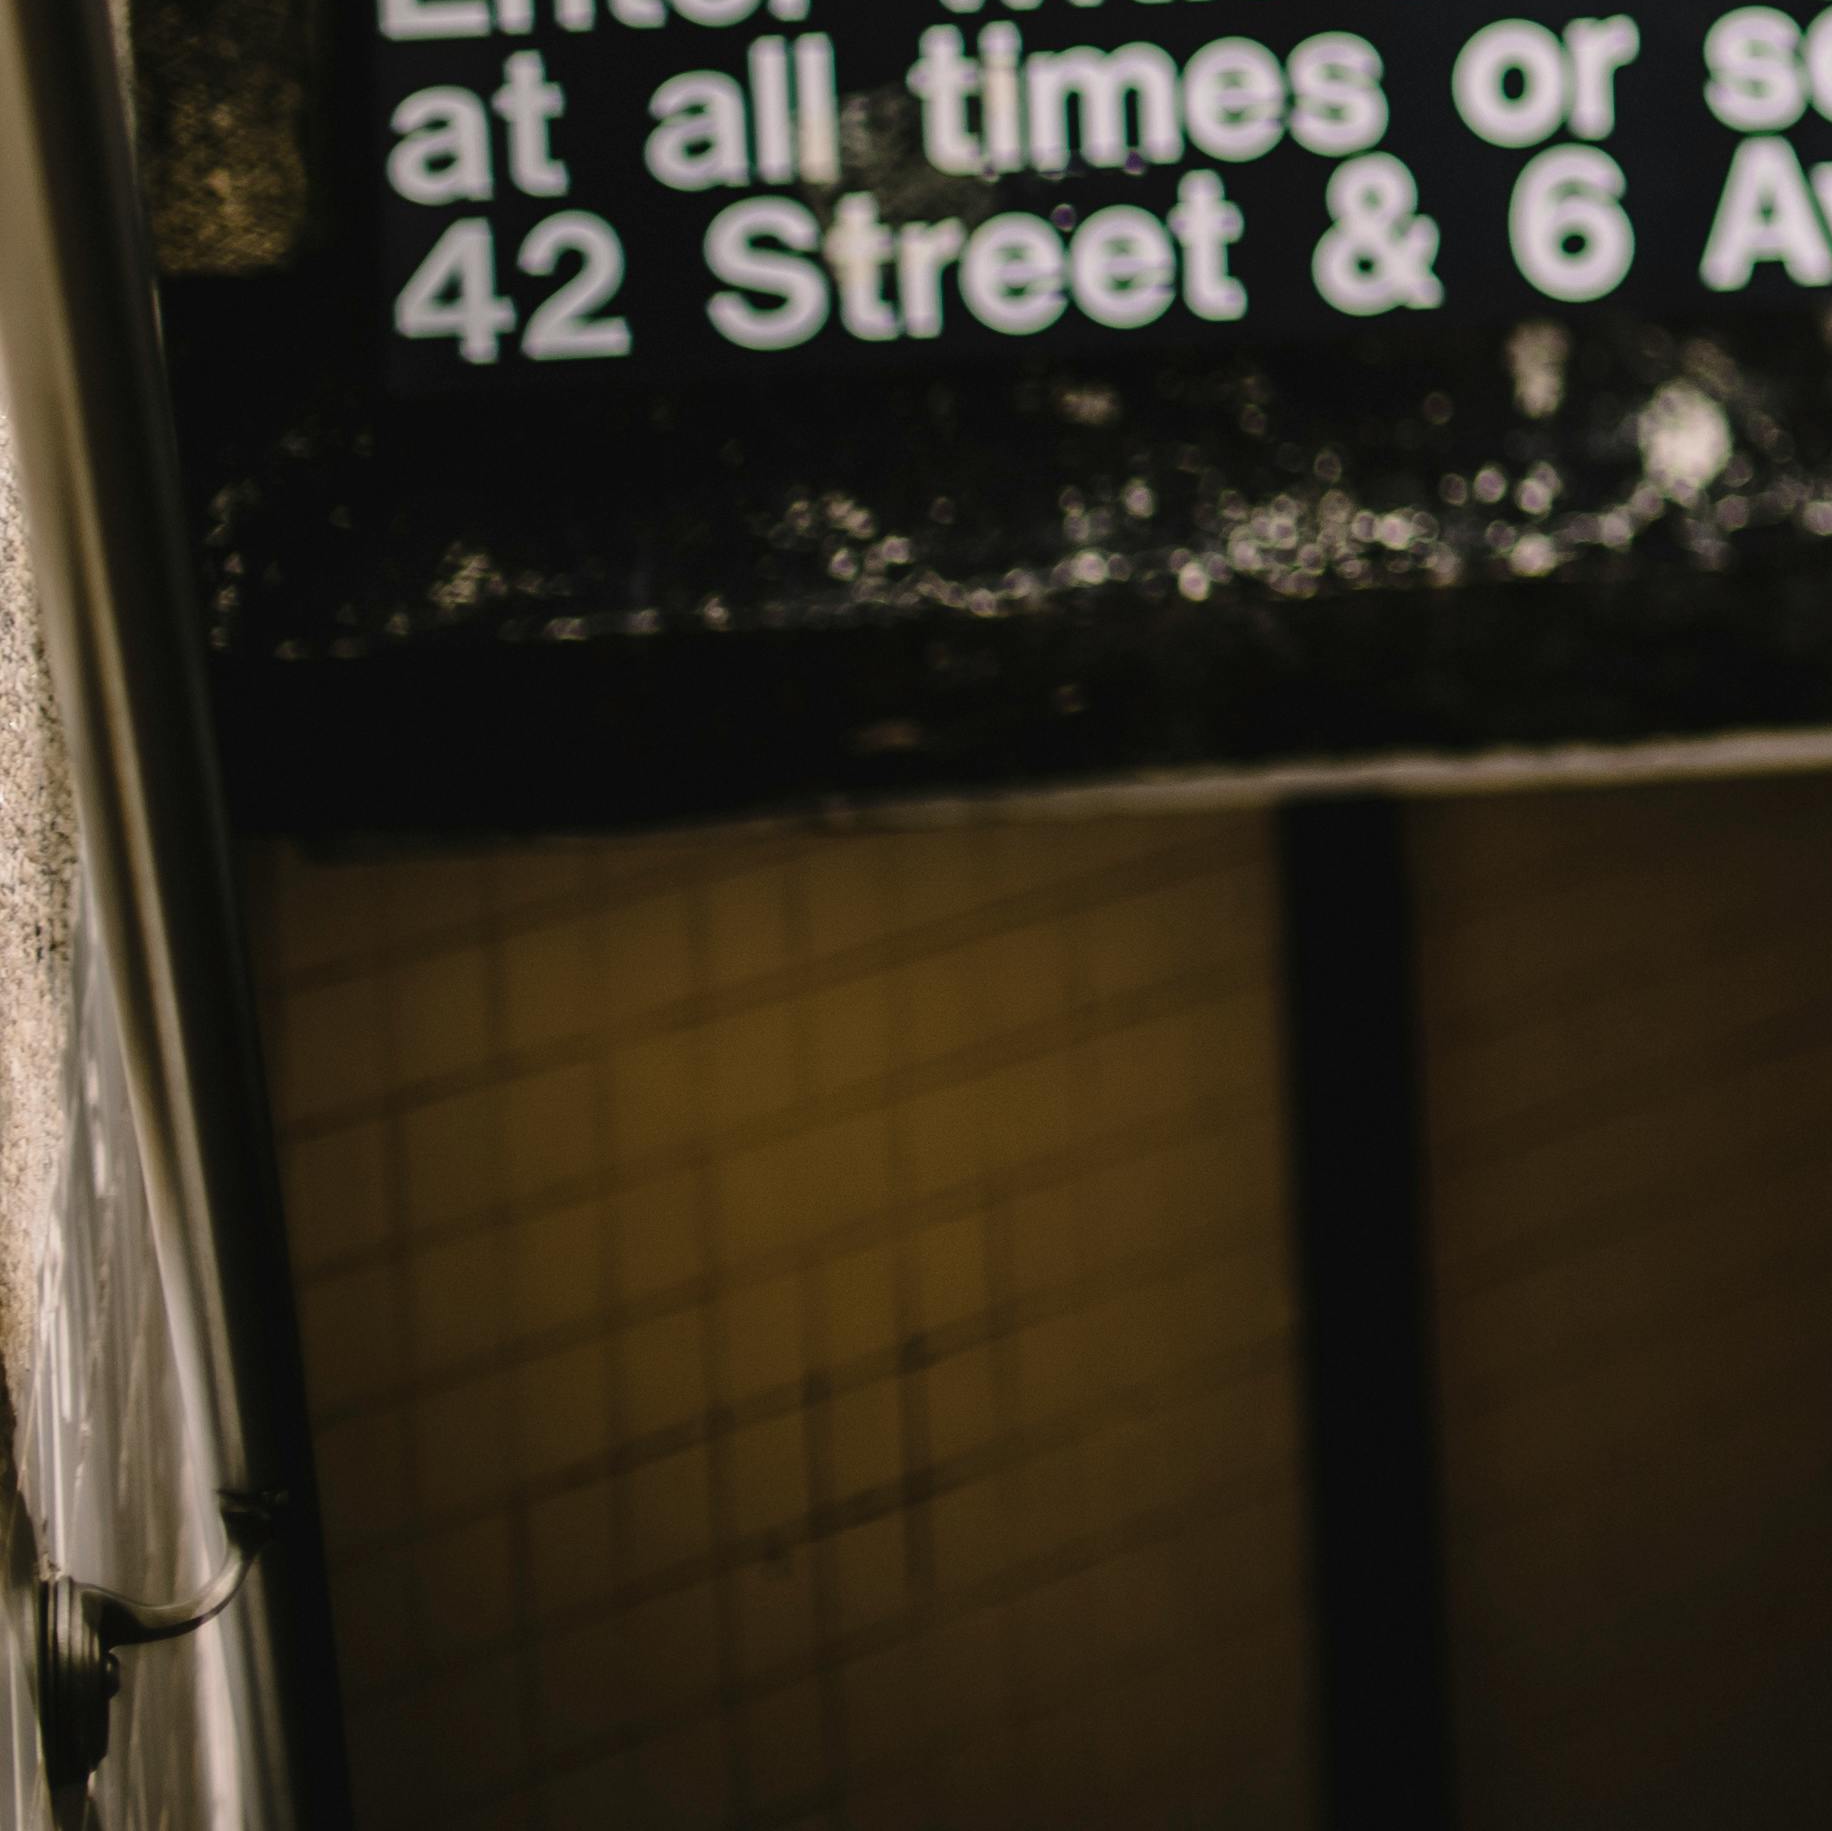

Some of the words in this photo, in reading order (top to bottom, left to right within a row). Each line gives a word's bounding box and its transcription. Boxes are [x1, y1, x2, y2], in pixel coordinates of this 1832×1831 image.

[387, 50, 570, 206] at
[643, 32, 841, 192] all
[908, 19, 1391, 176] times
[1450, 13, 1641, 149] or
[394, 209, 631, 364] 42
[702, 168, 1249, 351] Street
[1310, 151, 1445, 317] &
[1507, 142, 1637, 304] 6
